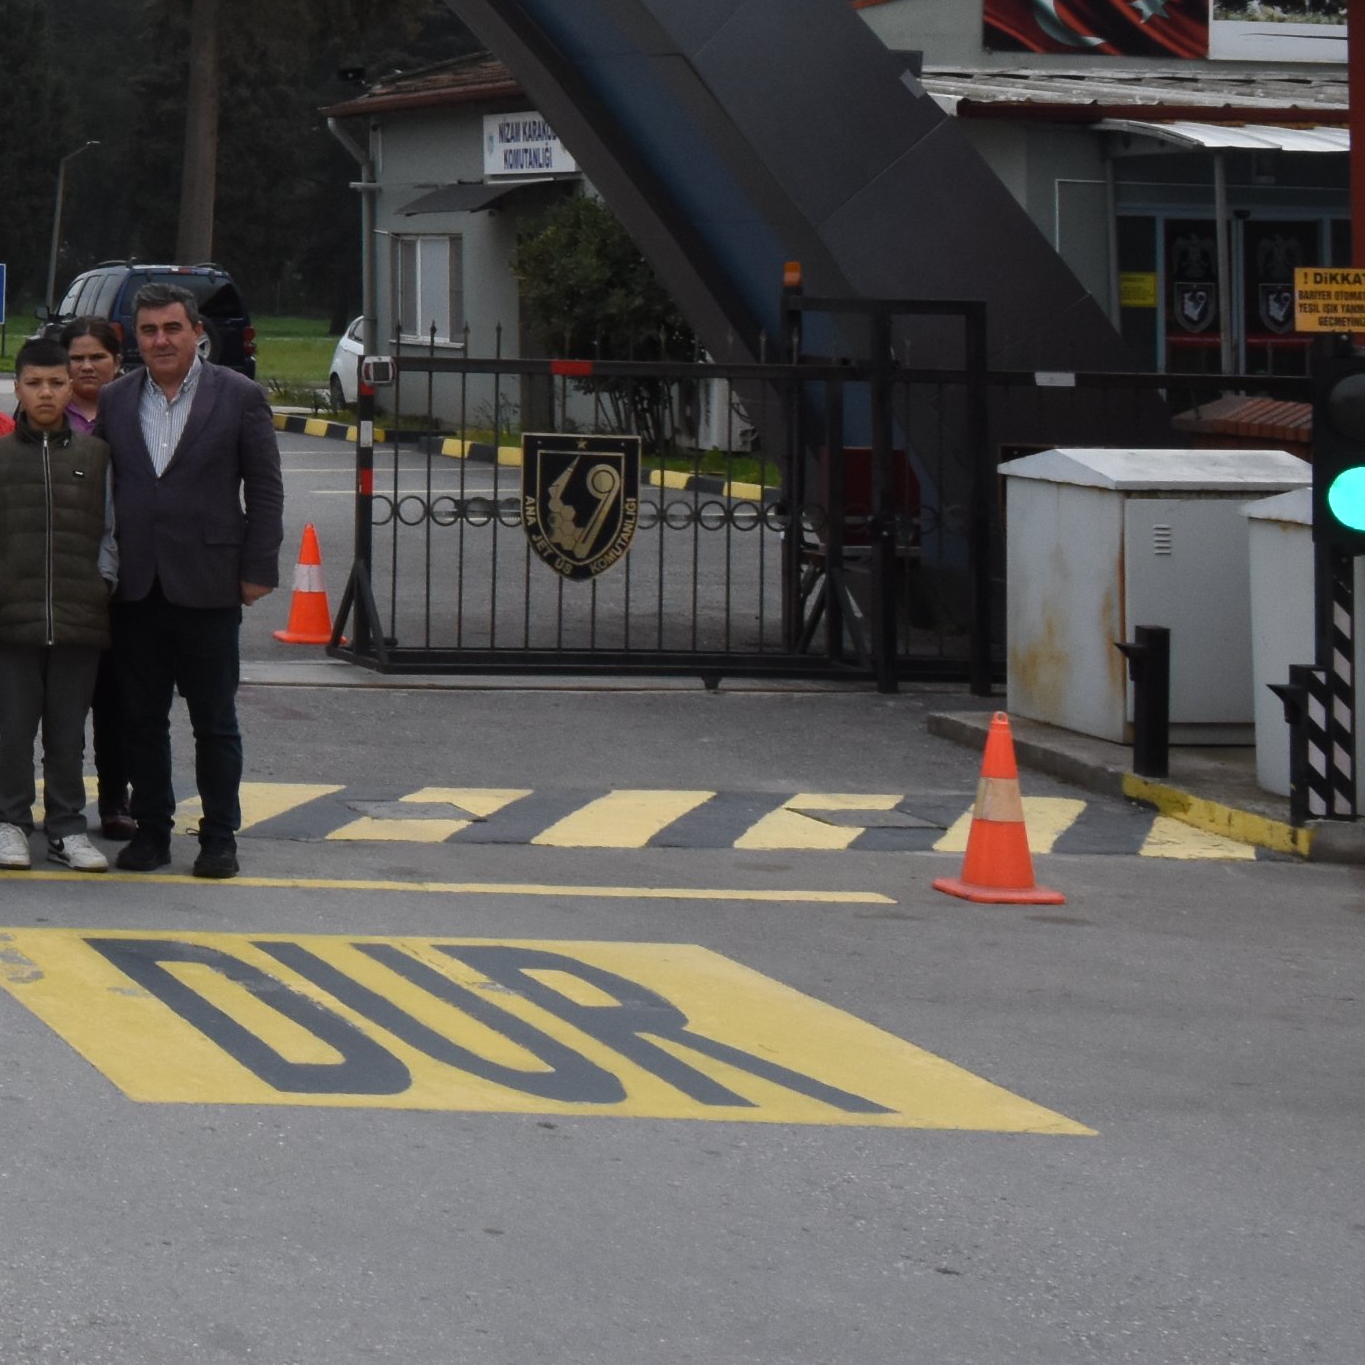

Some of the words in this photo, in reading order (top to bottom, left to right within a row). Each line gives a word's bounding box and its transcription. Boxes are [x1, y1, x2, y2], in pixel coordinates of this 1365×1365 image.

[525, 495, 536, 526] ANA
[532, 535, 551, 557] JET
[81, 937, 901, 1115] DUR
